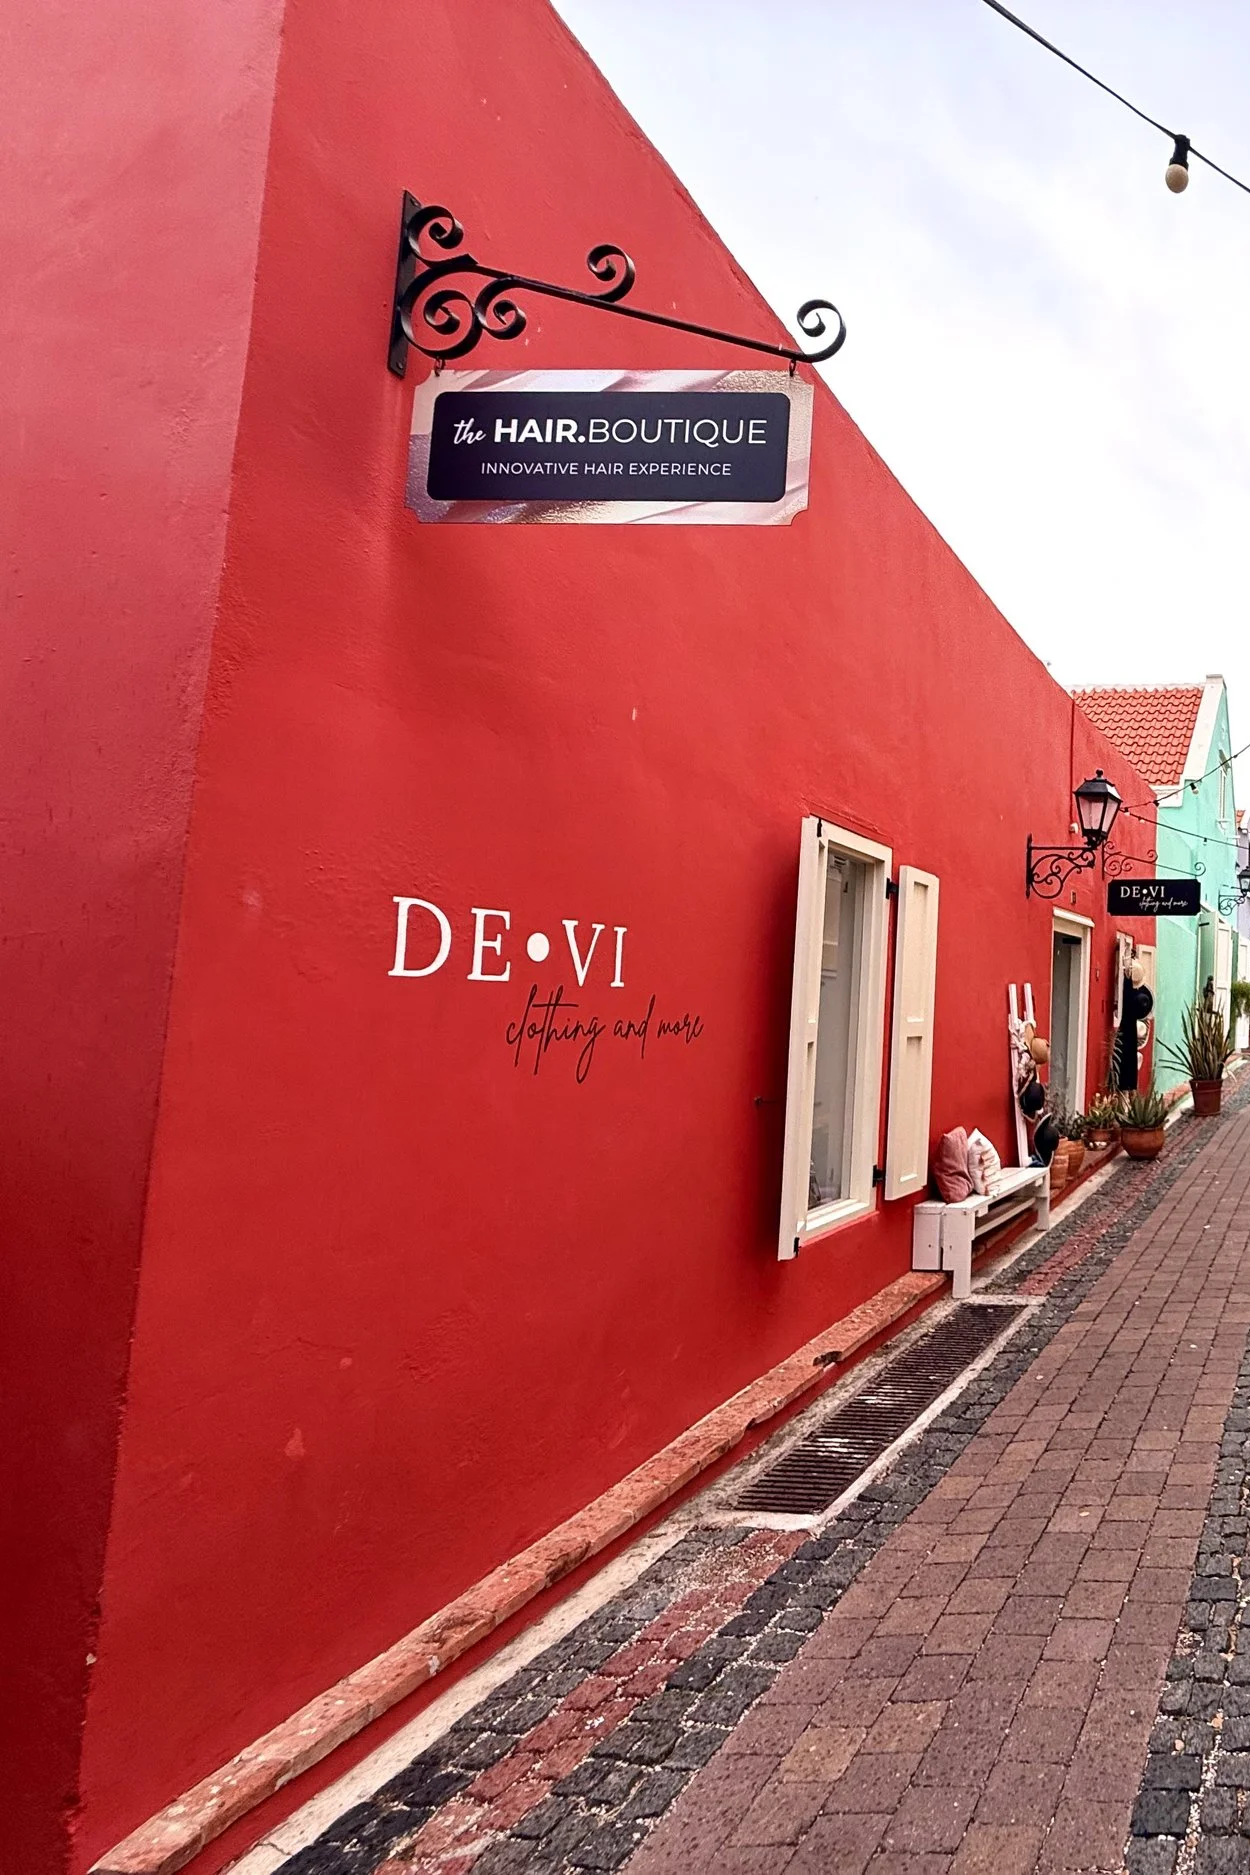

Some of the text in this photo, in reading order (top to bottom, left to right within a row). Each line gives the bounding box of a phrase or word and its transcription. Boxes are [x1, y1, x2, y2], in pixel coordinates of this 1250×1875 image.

[453, 417, 487, 445] the
[481, 461, 732, 477] INNOVATIVE HAIR EXPERIENCE
[506, 984, 705, 1084] clothing and more
